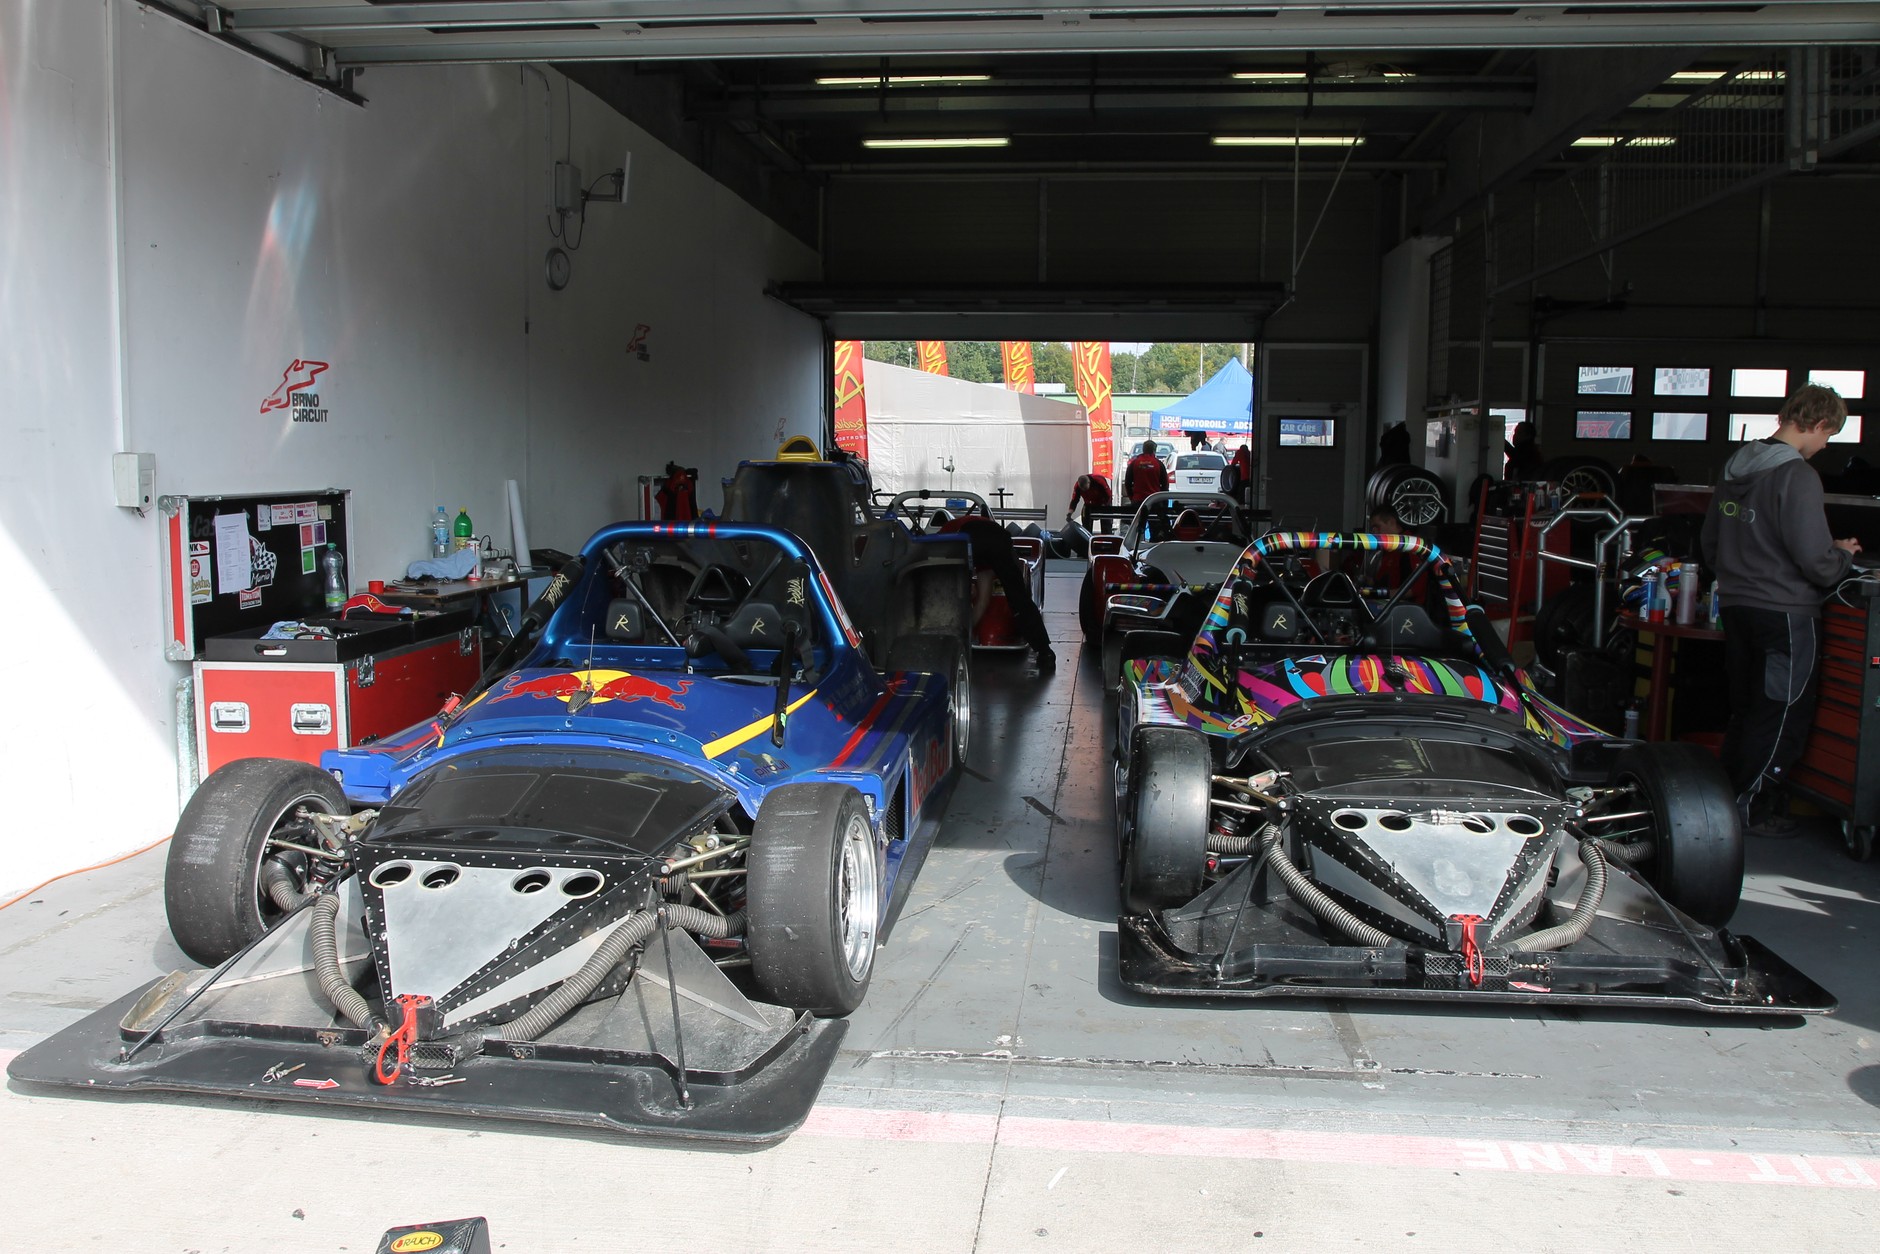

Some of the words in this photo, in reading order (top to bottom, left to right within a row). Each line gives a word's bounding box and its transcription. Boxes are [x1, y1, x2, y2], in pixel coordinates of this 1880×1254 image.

[292, 392, 320, 408] BRNO
[292, 409, 329, 422] CIRCUIT
[1182, 418, 1227, 429] MOTOROILS
[615, 613, 630, 632] R
[750, 617, 766, 635] R
[1272, 614, 1288, 630] R
[1400, 618, 1415, 635] R
[402, 1236, 437, 1249] RAUCH
